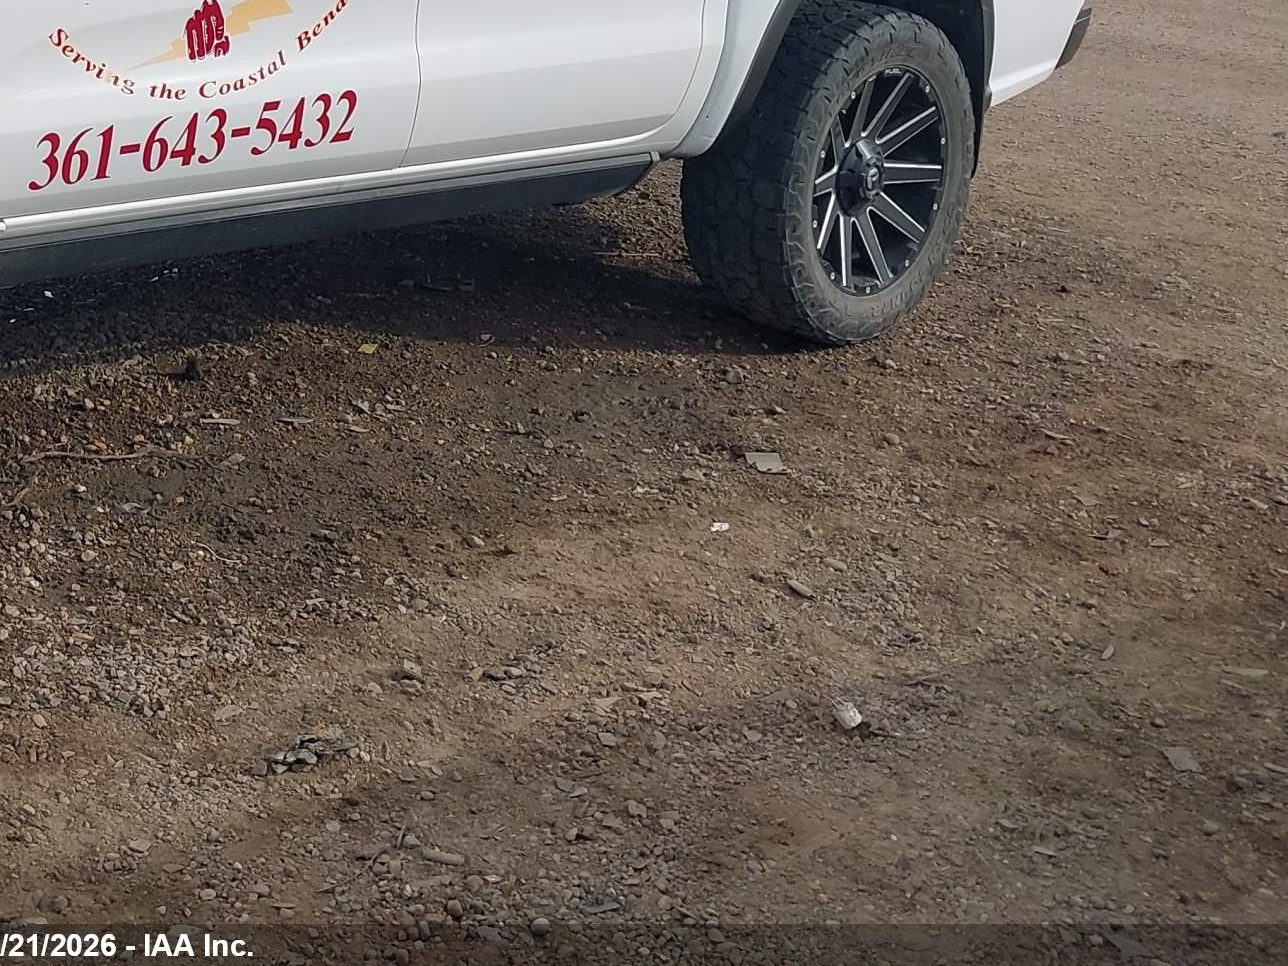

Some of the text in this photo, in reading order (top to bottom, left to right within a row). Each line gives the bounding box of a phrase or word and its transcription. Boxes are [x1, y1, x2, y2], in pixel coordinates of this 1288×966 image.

[48, 28, 136, 95] Serving
[148, 83, 187, 100] the
[198, 50, 287, 99] Coastal
[27, 89, 358, 191] 361-643-5432
